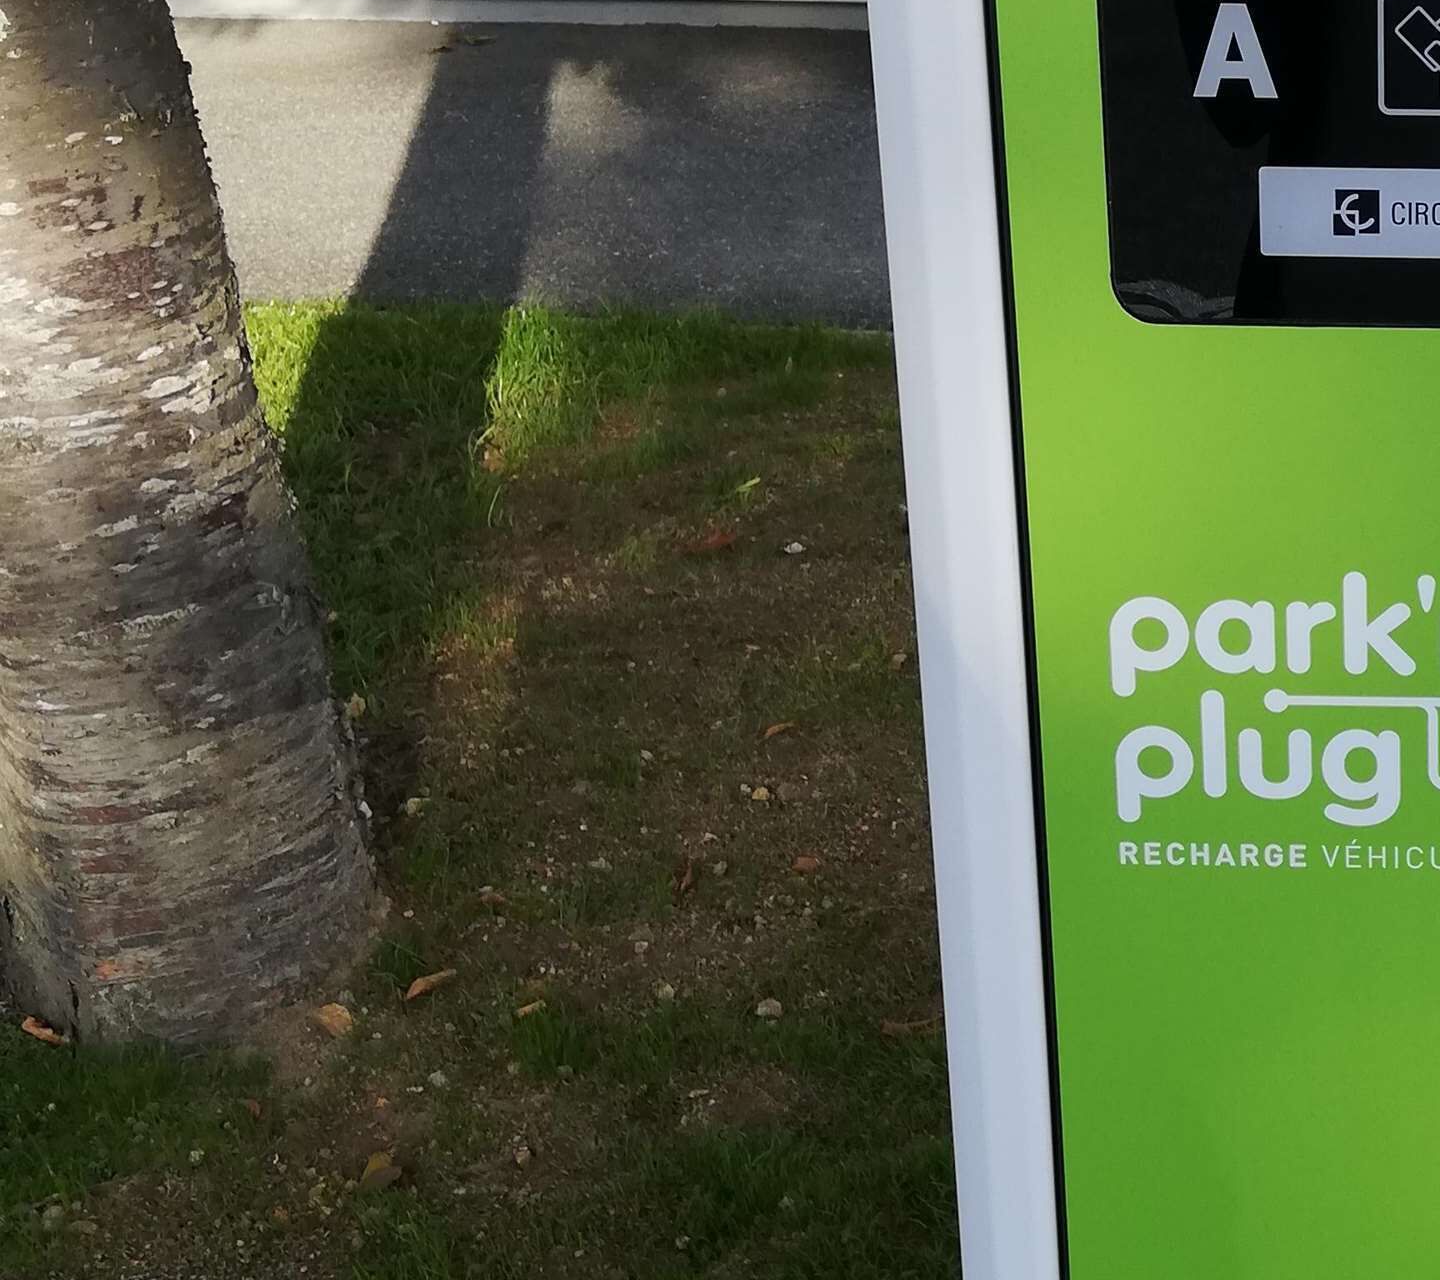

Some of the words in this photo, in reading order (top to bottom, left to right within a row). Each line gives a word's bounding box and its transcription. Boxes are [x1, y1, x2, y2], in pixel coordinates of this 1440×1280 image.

[1192, 3, 1278, 99] A
[1115, 690, 1401, 826] plug
[1118, 841, 1307, 868] RECHARGE
